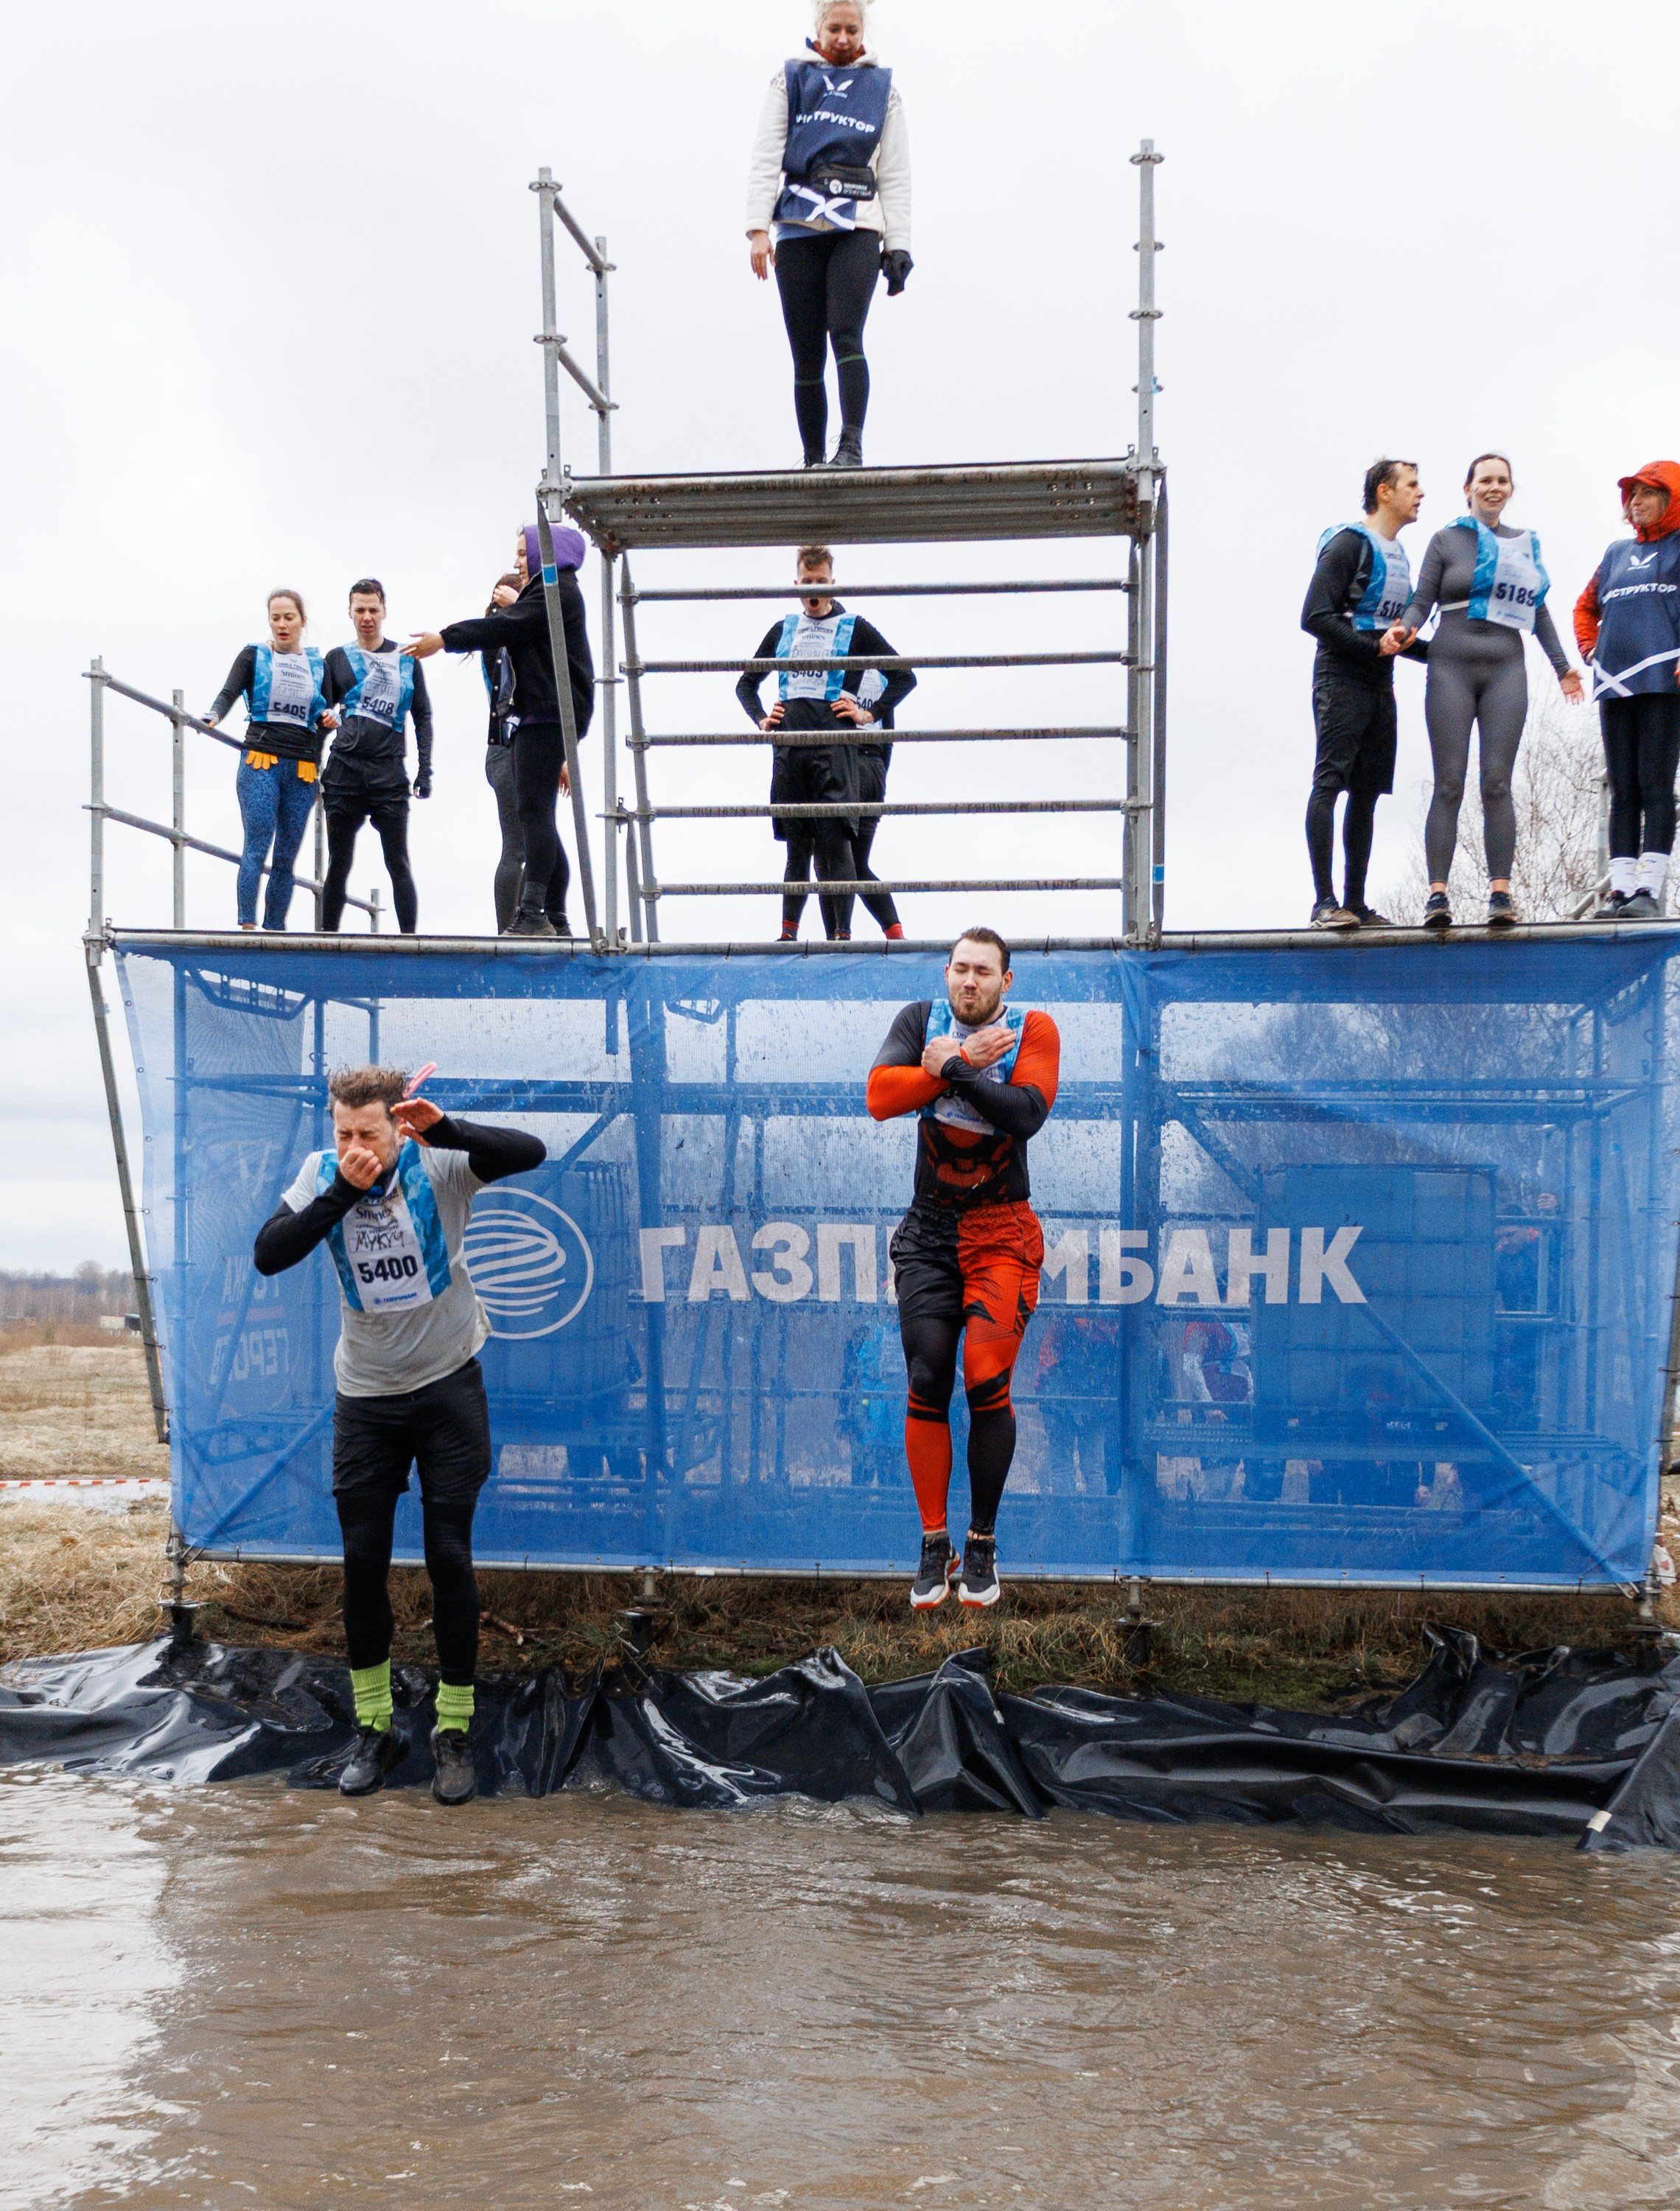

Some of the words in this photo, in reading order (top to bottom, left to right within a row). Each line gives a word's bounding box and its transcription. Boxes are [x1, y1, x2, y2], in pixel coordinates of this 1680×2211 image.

[273, 702, 307, 720] 5405
[362, 696, 395, 715] 5408
[357, 1254, 419, 1284] 5400
[639, 1222, 1367, 1305] ГАЗПМБАНК
